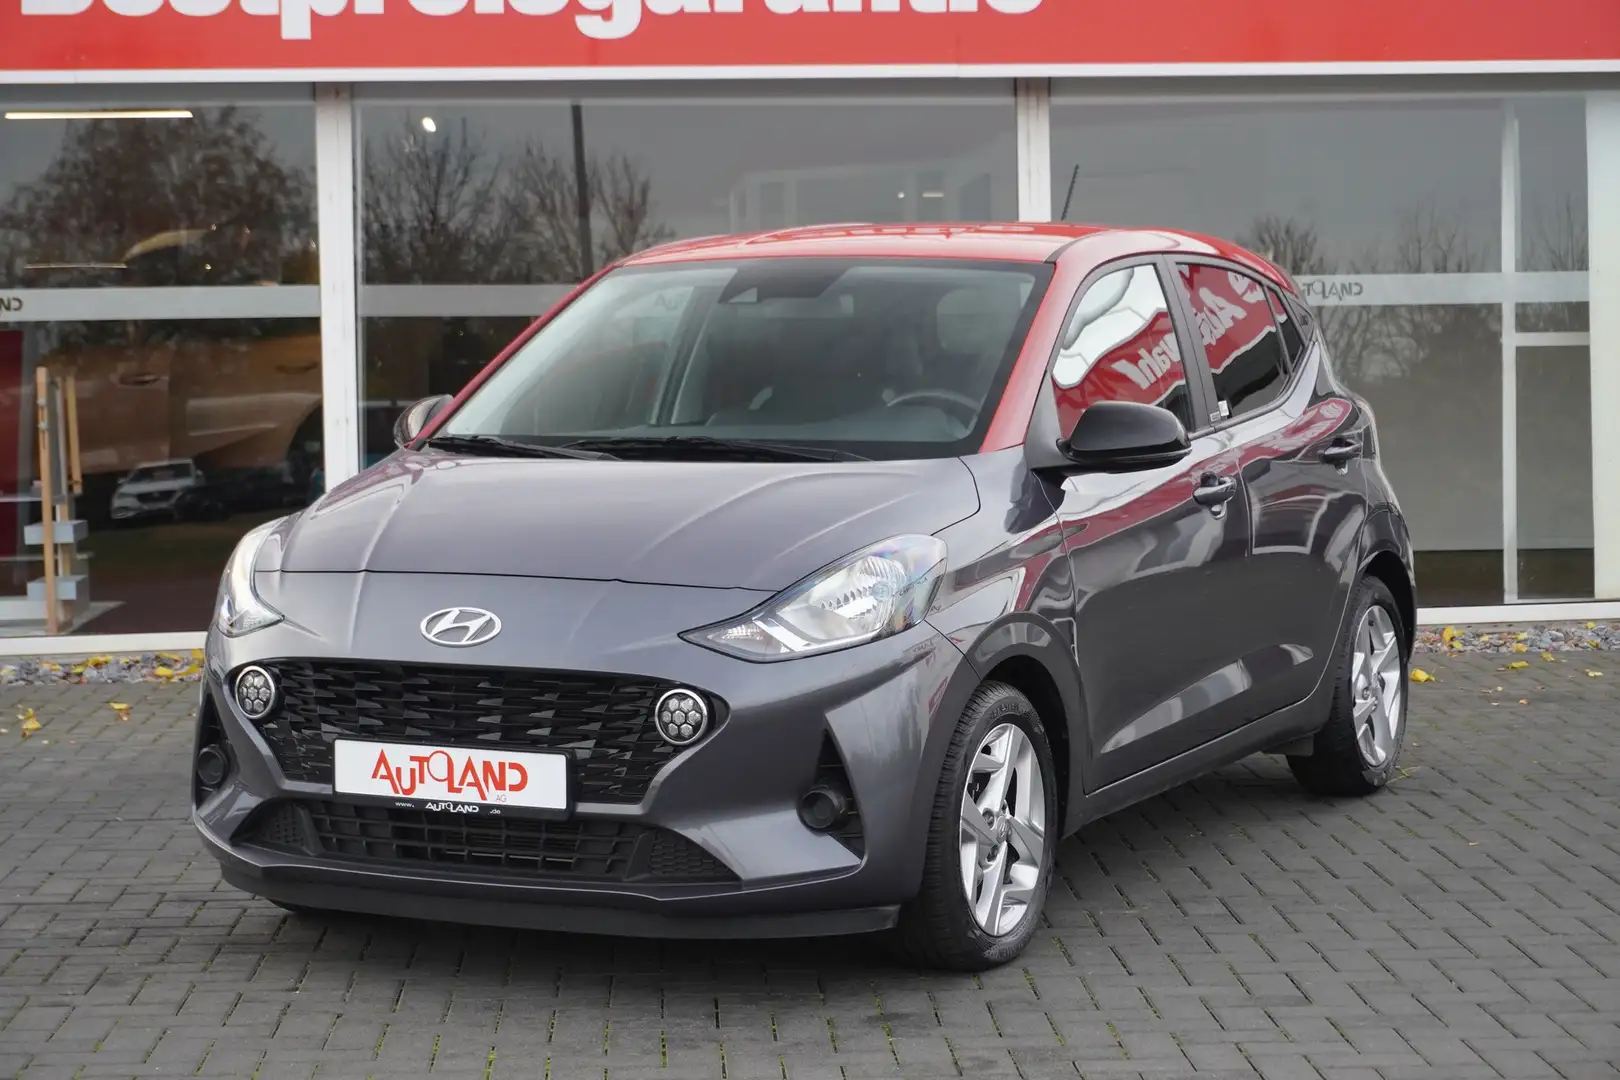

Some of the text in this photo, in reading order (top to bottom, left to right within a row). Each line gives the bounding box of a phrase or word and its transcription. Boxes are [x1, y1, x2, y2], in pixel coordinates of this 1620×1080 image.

[1303, 279, 1363, 301] TOLAND
[371, 749, 528, 801] AUTOLAND
[495, 793, 507, 803] AG
[425, 801, 479, 814] AUTOLAND
